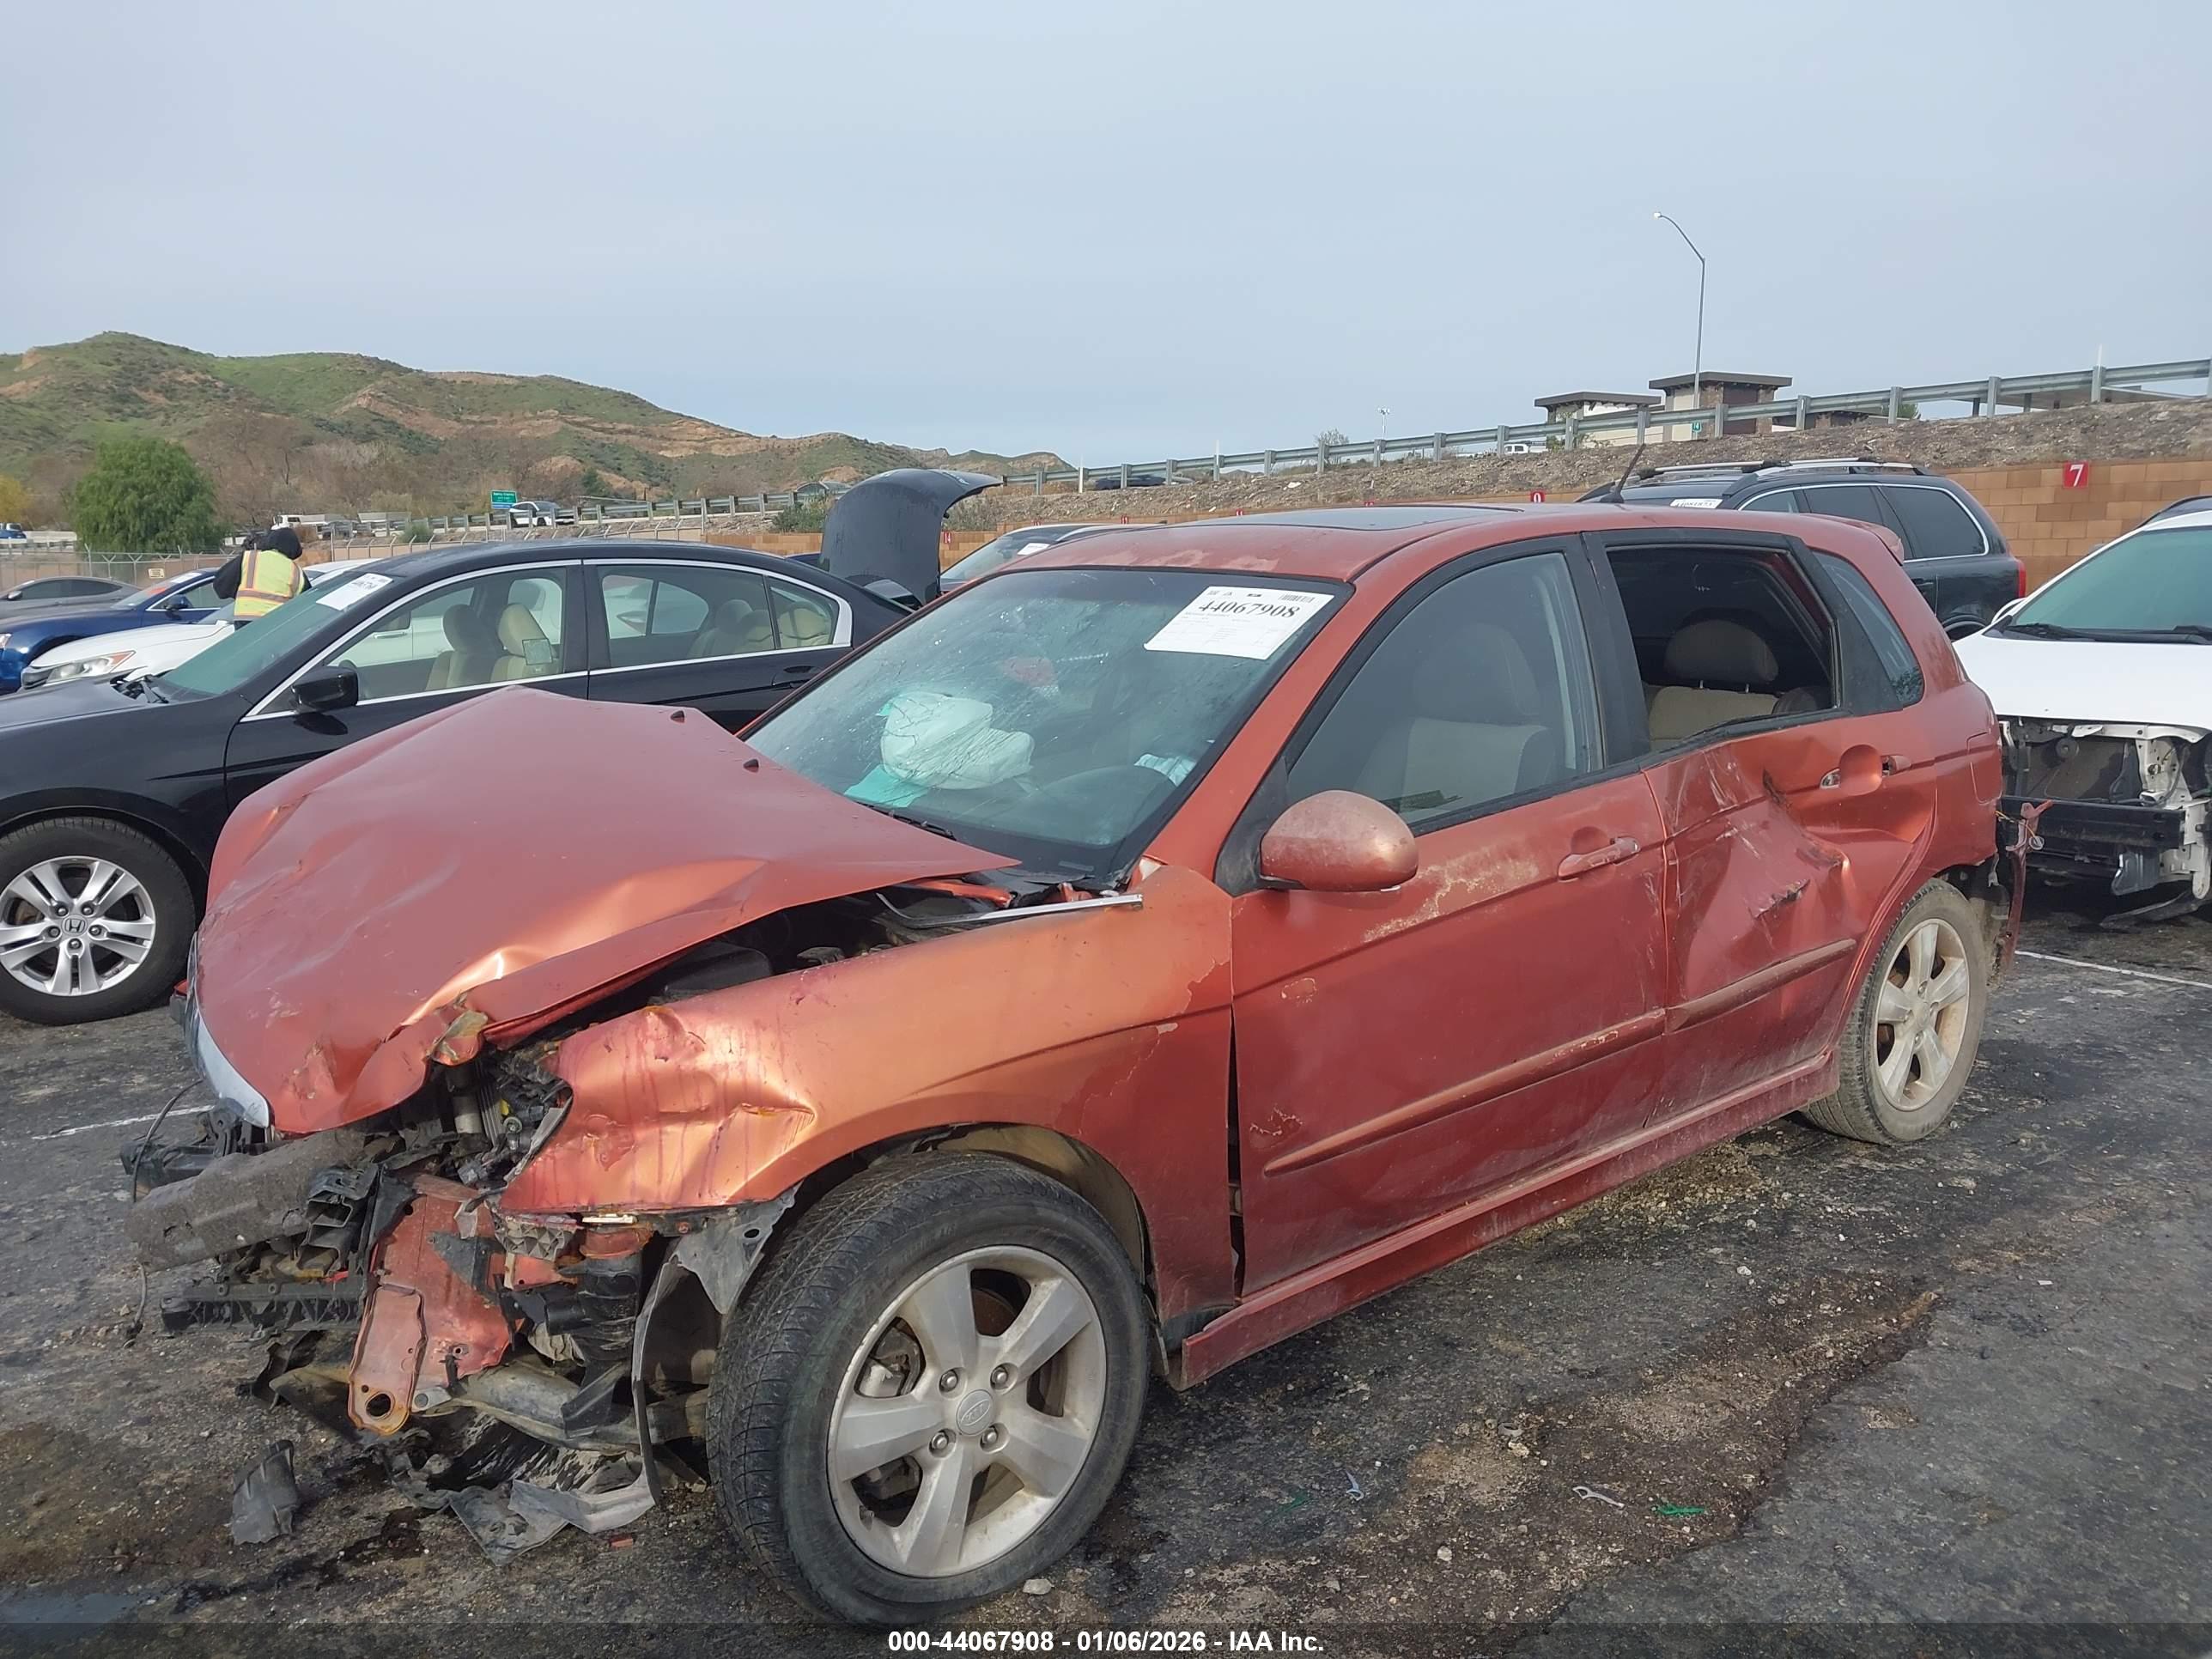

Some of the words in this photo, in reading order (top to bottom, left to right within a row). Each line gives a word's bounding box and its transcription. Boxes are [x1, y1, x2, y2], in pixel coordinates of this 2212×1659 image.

[2069, 464, 2084, 487] 7
[945, 532, 951, 544] 14
[1198, 600, 1301, 618] 44067908
